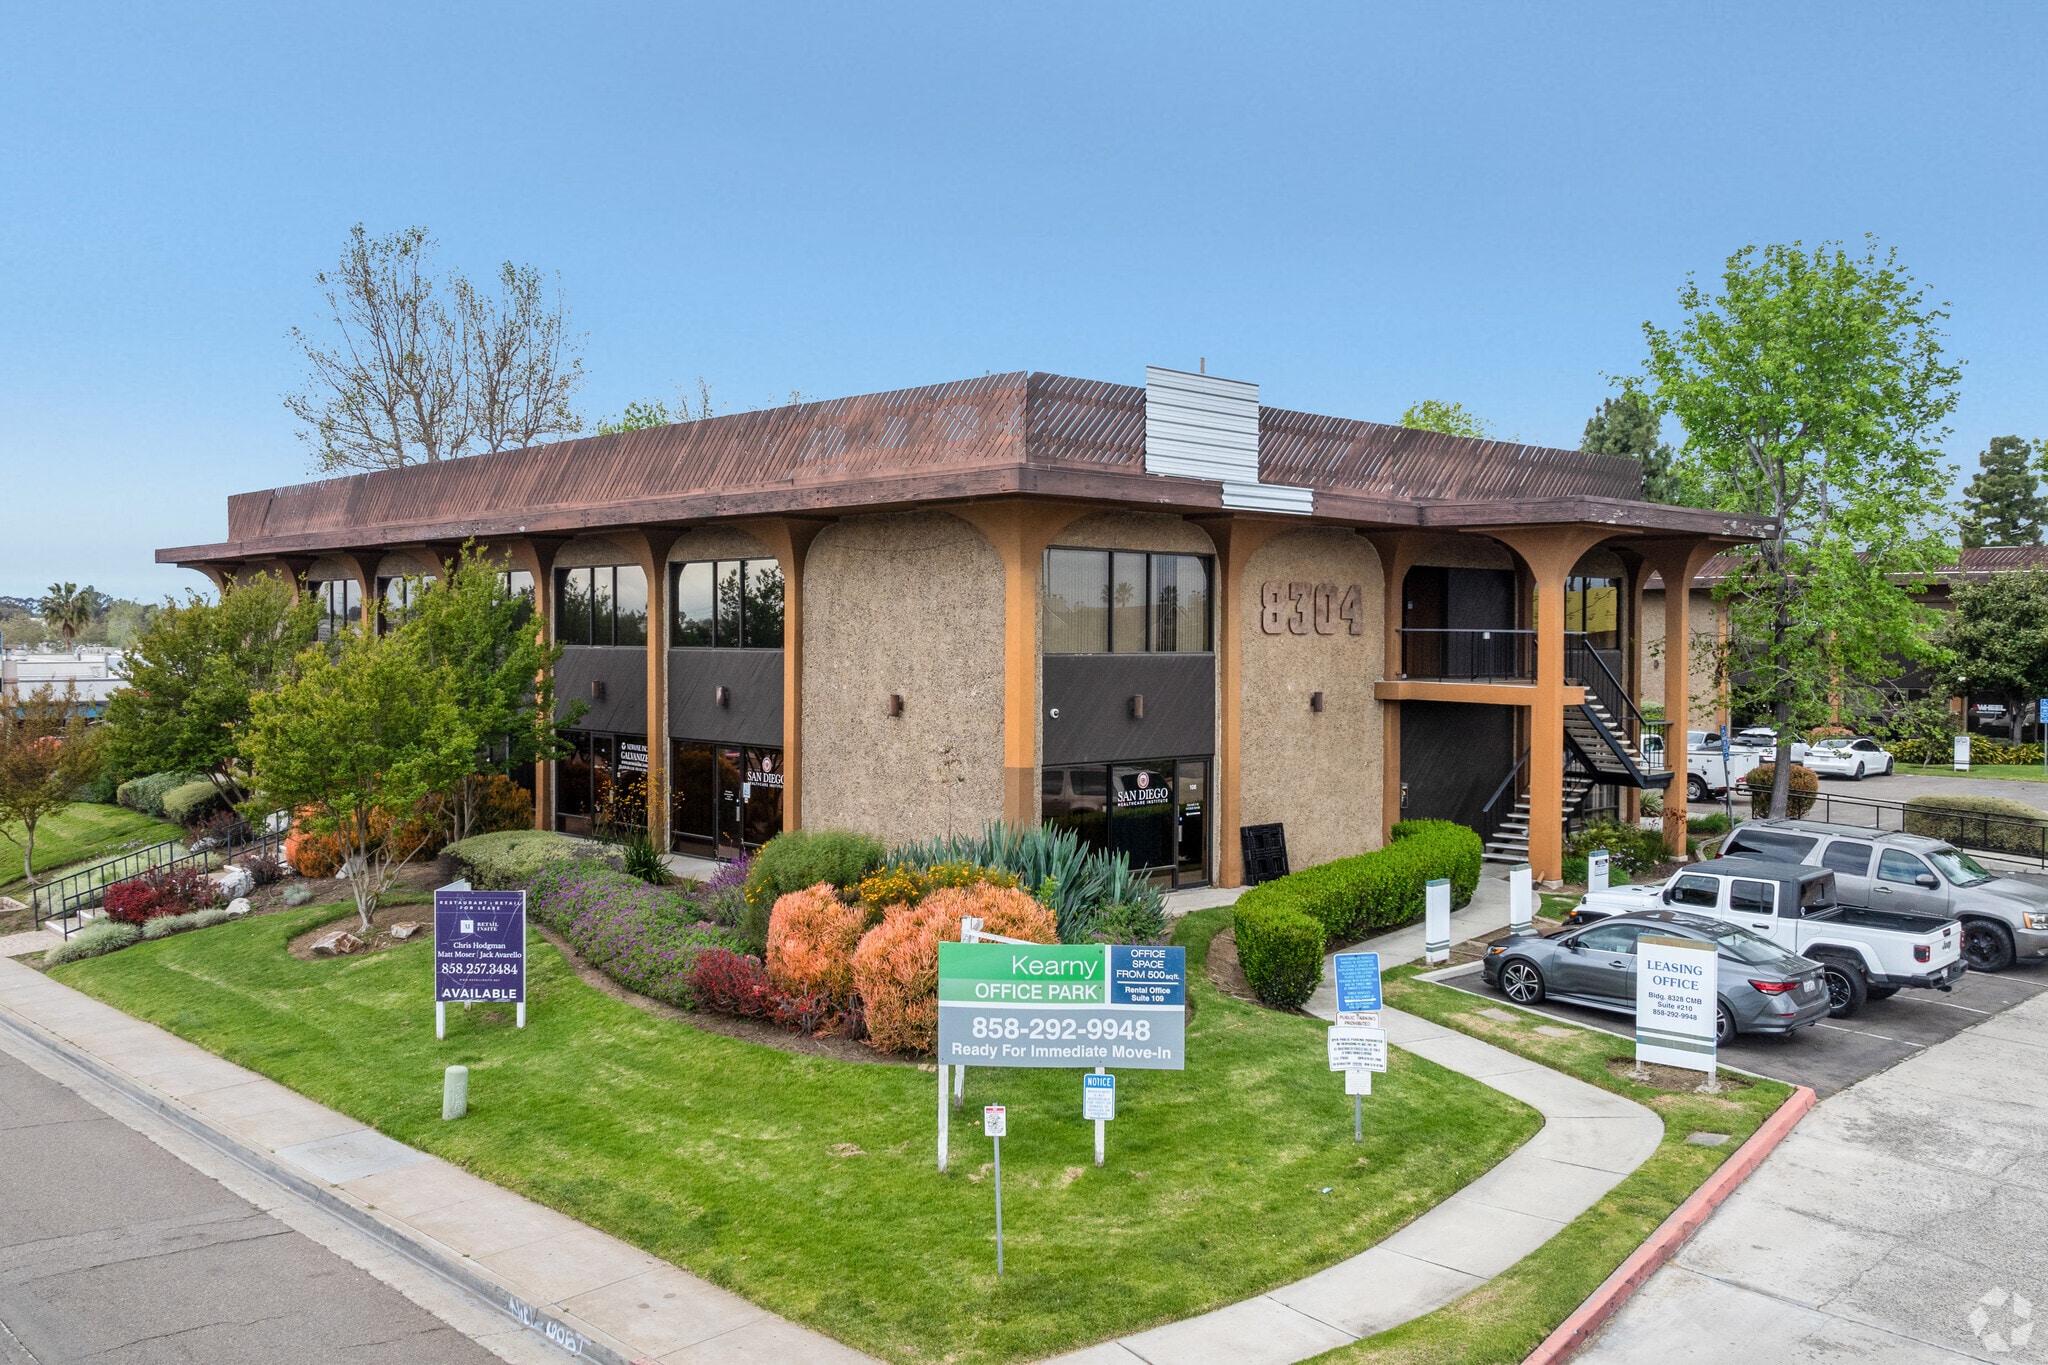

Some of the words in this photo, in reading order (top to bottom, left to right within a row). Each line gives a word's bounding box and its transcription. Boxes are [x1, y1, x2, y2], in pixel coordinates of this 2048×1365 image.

[1261, 581, 1363, 635] 8304
[748, 770, 762, 782] SAN
[1118, 790, 1136, 802] SAN
[1139, 788, 1168, 800] DIEGO
[473, 942, 506, 950] Hodgman
[479, 951, 493, 959] Jack
[1130, 949, 1166, 958] OFFICE
[441, 963, 518, 974] 858.257.3484
[1012, 955, 1098, 980] Kearny
[1132, 960, 1164, 968] SPACE
[1647, 960, 1703, 976] LEASING
[1116, 970, 1145, 978] FROM
[1148, 971, 1165, 979] 500
[1652, 975, 1699, 990] OFFICE
[442, 988, 517, 999] AVAILABLE
[975, 983, 1042, 1000] OFFICE
[1048, 984, 1097, 1000] PARK
[1125, 986, 1147, 994] Rental
[1648, 992, 1665, 1001] Bldg.
[1686, 997, 1702, 1005] CMB
[1657, 1001, 1675, 1009] Suite
[1652, 1009, 1698, 1020] 858-292-9948
[972, 1017, 1151, 1041] 858-292-9948
[952, 1042, 998, 1059] Ready
[1002, 1044, 1026, 1057] For
[1031, 1044, 1108, 1058] Immediate
[1112, 1045, 1171, 1059] Move-In
[1087, 1077, 1112, 1087] NOTICE
